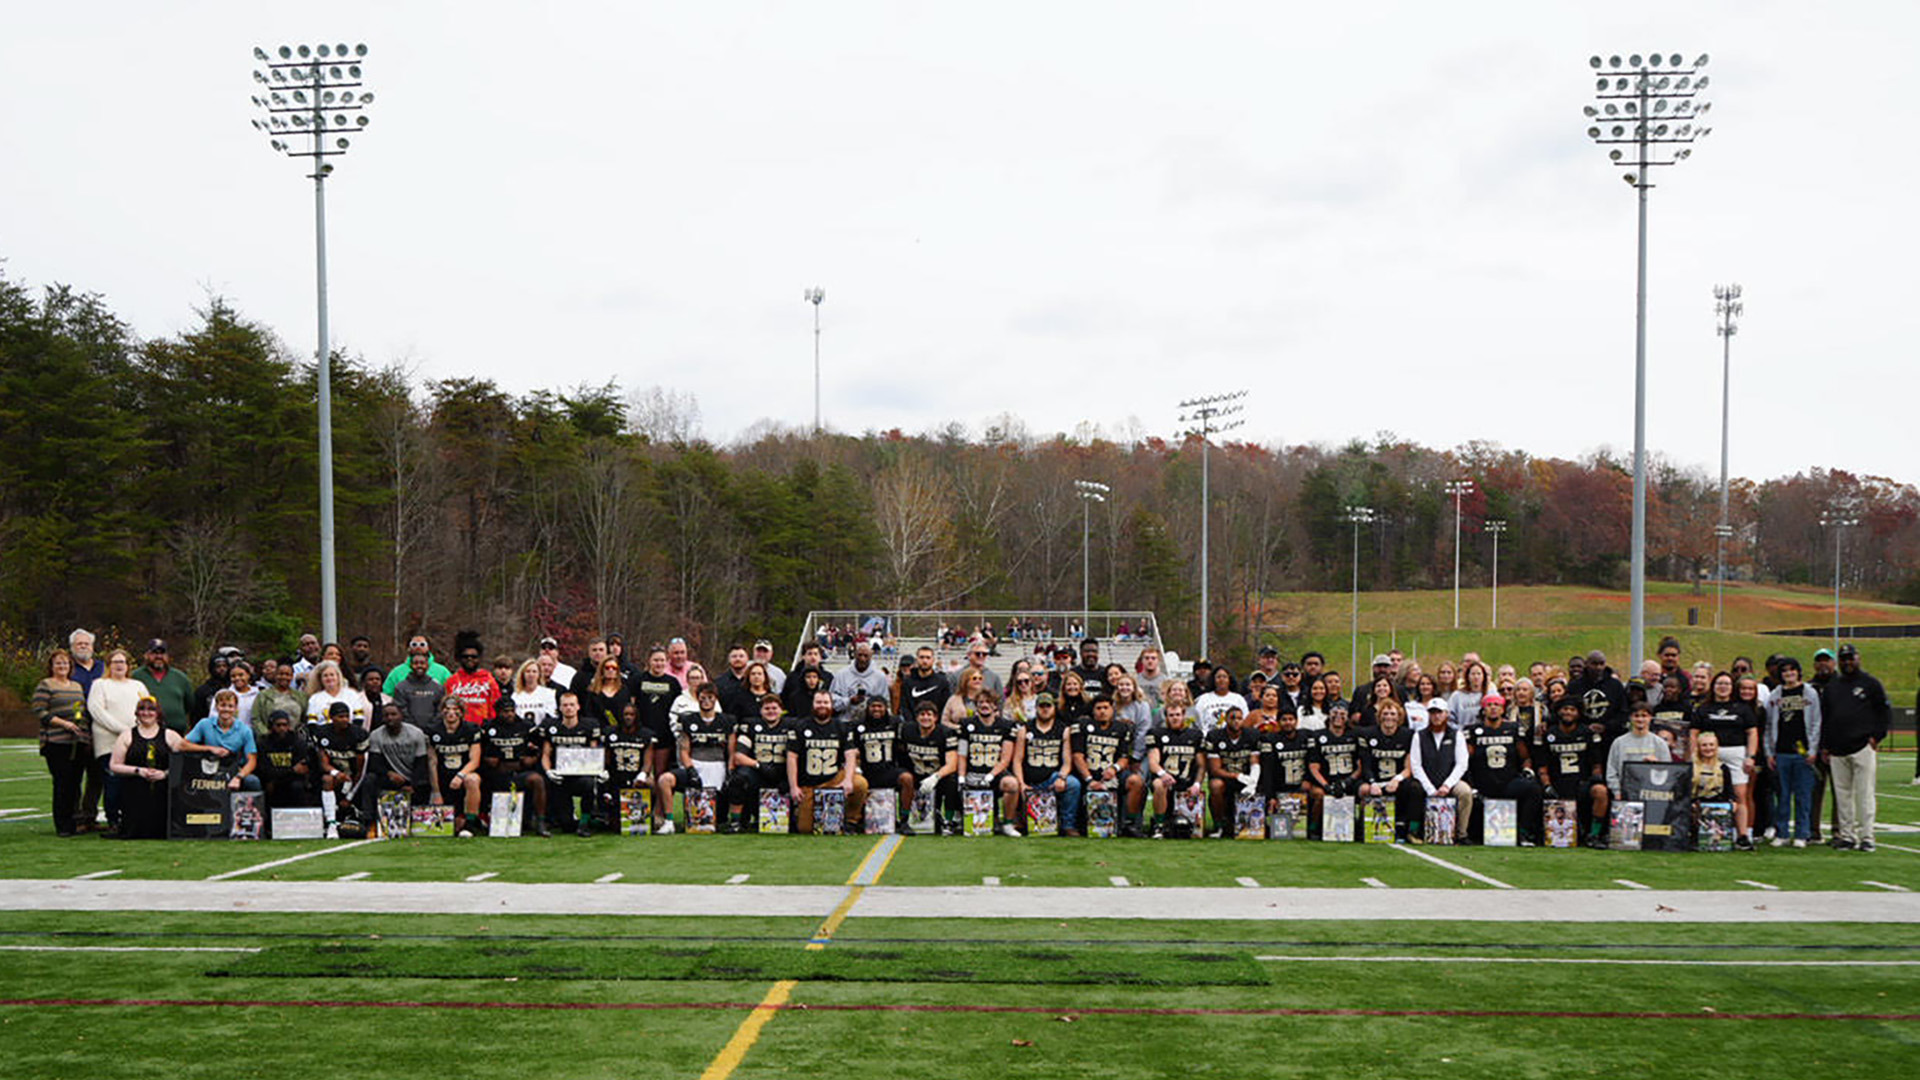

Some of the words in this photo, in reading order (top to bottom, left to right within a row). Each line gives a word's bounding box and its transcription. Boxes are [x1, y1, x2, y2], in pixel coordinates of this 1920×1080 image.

[861, 731, 896, 741] FERRUM
[969, 734, 1003, 743] FERRUM
[1087, 735, 1119, 746] FERRUM
[1477, 736, 1514, 745] FERRUM
[806, 739, 840, 748] FERRUM
[1321, 744, 1356, 754] FERRUM
[1550, 743, 1588, 753] FERRUM
[865, 739, 893, 763] 81
[1163, 745, 1195, 754] FERRUM
[1371, 749, 1406, 759] FERRUM
[807, 748, 839, 776] 62
[1087, 745, 1117, 771] 53
[1486, 745, 1507, 768] 6
[1164, 754, 1195, 779] 47
[1324, 753, 1353, 776] 10
[1378, 758, 1397, 779] 9
[1561, 753, 1580, 774] 2
